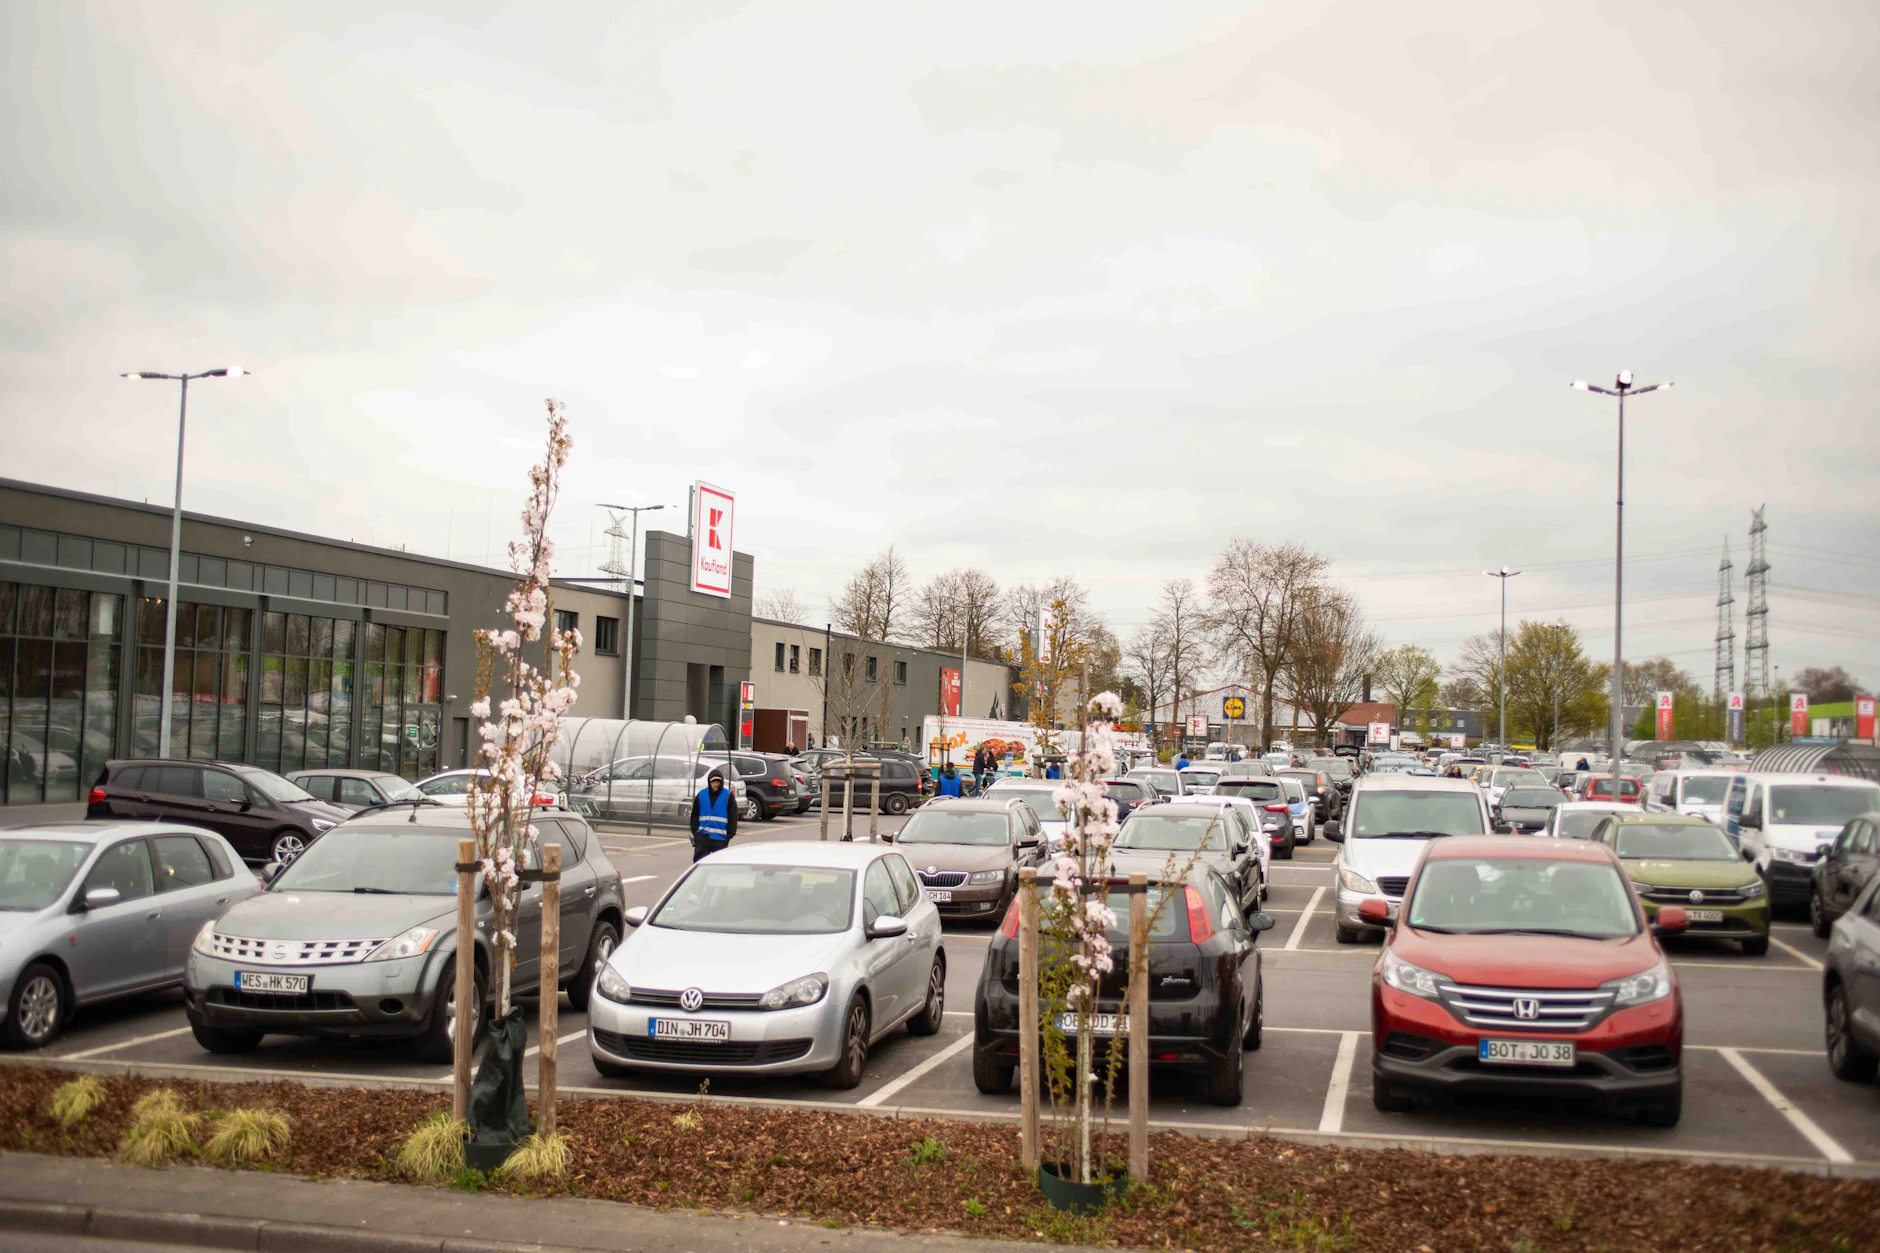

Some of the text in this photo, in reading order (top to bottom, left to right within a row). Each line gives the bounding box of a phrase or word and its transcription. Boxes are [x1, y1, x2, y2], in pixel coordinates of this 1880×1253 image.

[700, 556, 728, 576] Kaufland
[242, 974, 306, 990] WES HK 570
[658, 1021, 678, 1034] DIN
[687, 1023, 701, 1036] JH
[705, 1024, 726, 1037] 704
[1489, 1043, 1518, 1058] BOT
[1553, 1046, 1570, 1060] 38
